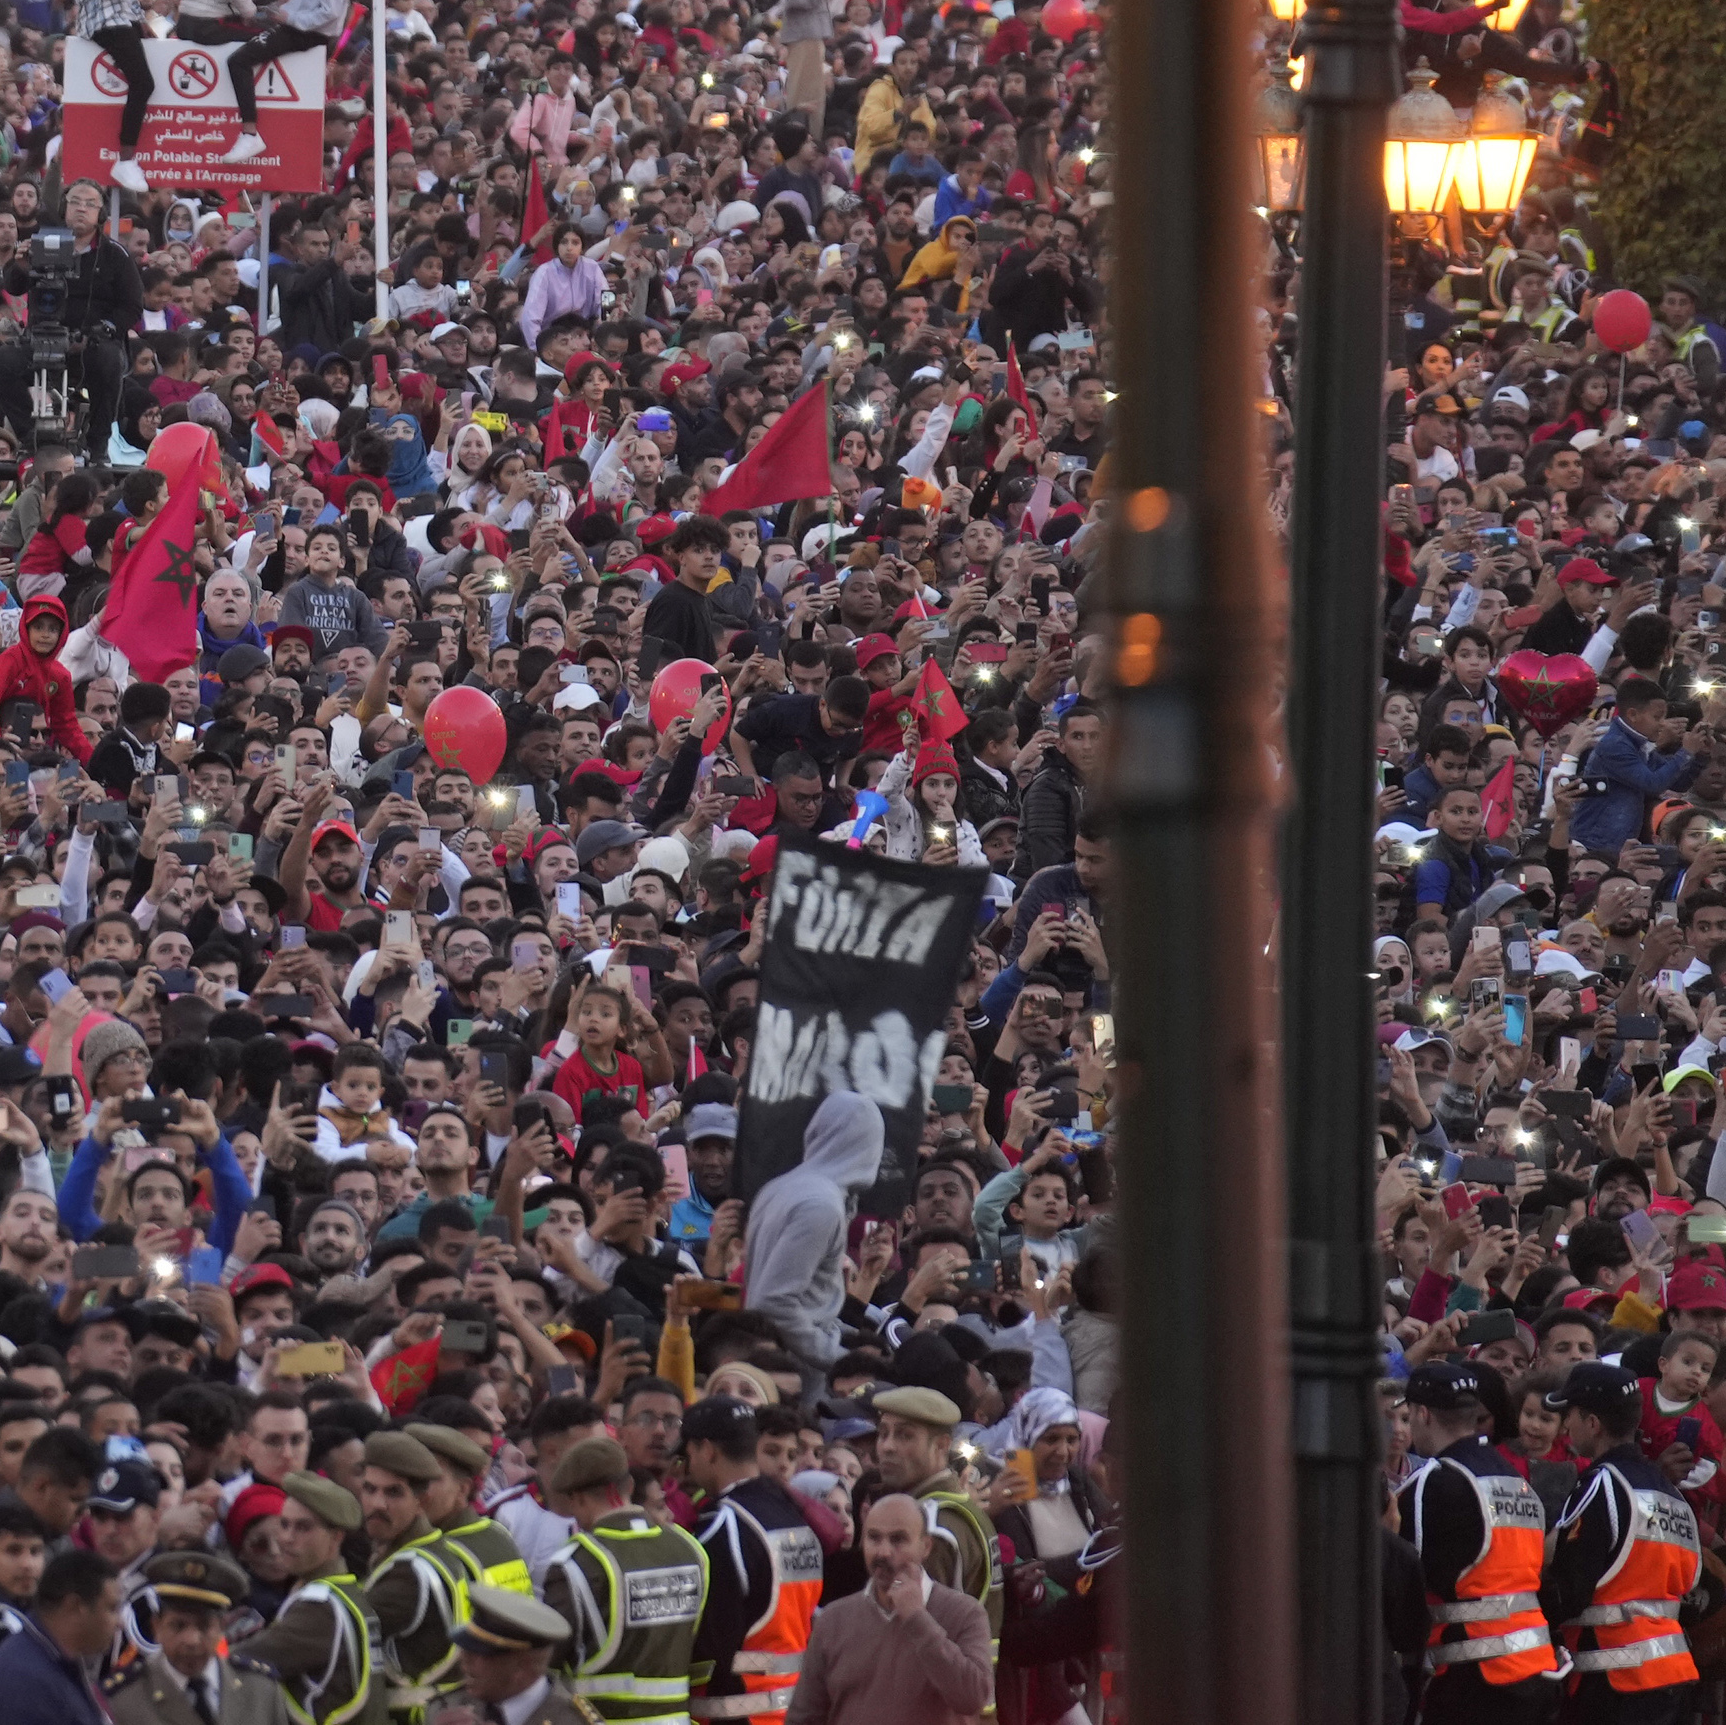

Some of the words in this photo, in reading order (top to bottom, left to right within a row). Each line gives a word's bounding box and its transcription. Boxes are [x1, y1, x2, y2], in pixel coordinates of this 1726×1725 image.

[176, 110, 206, 124] صالح
[207, 111, 228, 124] غير
[155, 128, 193, 145] للسقي
[133, 151, 150, 161] on
[154, 149, 203, 163] Potable
[205, 152, 281, 167] Strment
[185, 168, 193, 180] à
[196, 169, 262, 185] l'Arrosage
[310, 594, 351, 608] GUESS
[314, 606, 346, 619] LA-CA
[305, 615, 355, 631] ORIGINAL
[431, 730, 456, 741] QATAR
[1494, 1500, 1540, 1519] POLICE
[1646, 1516, 1694, 1541] POLICE
[782, 1555, 821, 1572] POLICE
